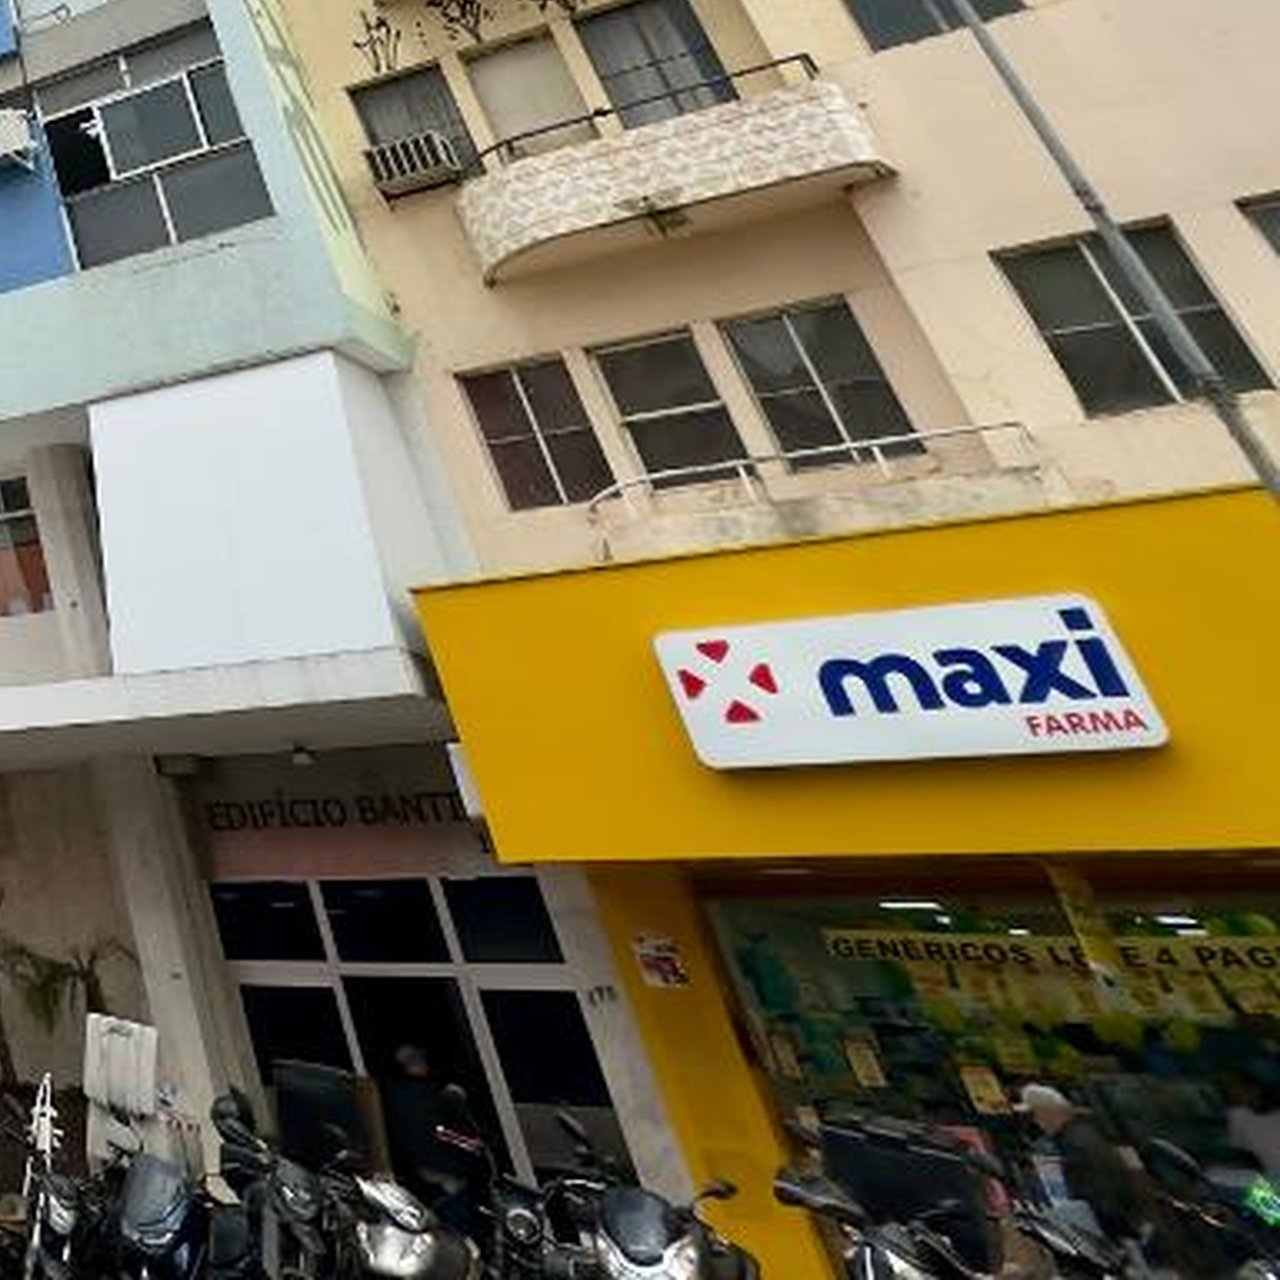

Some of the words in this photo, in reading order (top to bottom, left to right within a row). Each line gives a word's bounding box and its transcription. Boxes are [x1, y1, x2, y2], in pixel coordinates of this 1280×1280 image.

[817, 606, 1130, 717] maxi
[1025, 708, 1148, 738] FARMA
[1046, 945, 1148, 969] LEE
